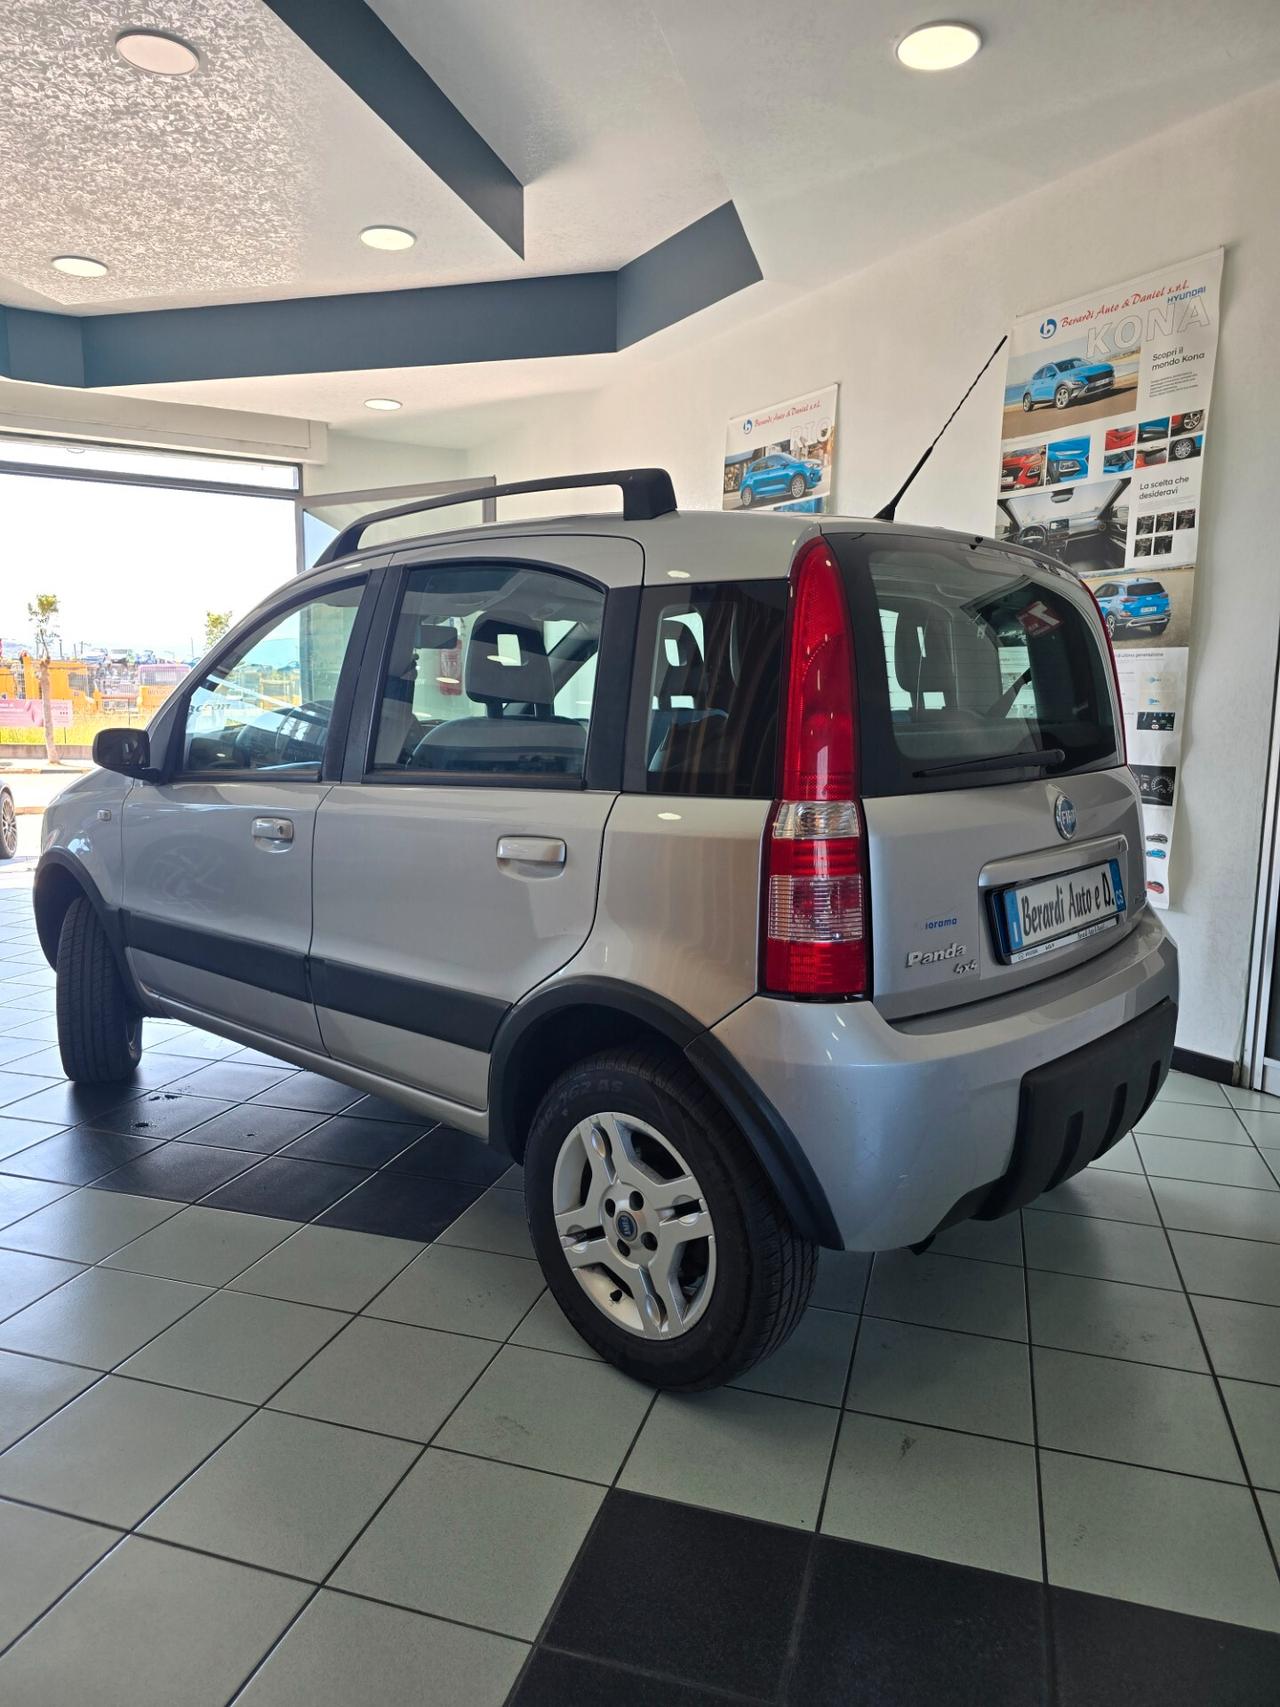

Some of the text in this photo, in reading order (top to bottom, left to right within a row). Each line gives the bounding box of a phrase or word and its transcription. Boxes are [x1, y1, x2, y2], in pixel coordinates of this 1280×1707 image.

[1167, 286, 1207, 304] HYUNDAI
[1061, 311, 1094, 328] Berardi
[1094, 304, 1120, 320] Auto
[1121, 298, 1131, 309] &
[1131, 287, 1165, 305] Daniel
[1086, 295, 1210, 359] KONA
[1151, 352, 1205, 371] mondo Kona
[1152, 347, 1177, 361] Scopri
[1150, 479, 1173, 488] scelta
[1174, 475, 1189, 484] che
[1139, 486, 1178, 499] desideravi
[1021, 871, 1115, 936] Berardi Auto e D.
[905, 942, 968, 968] Panda
[953, 960, 977, 974] 4x4
